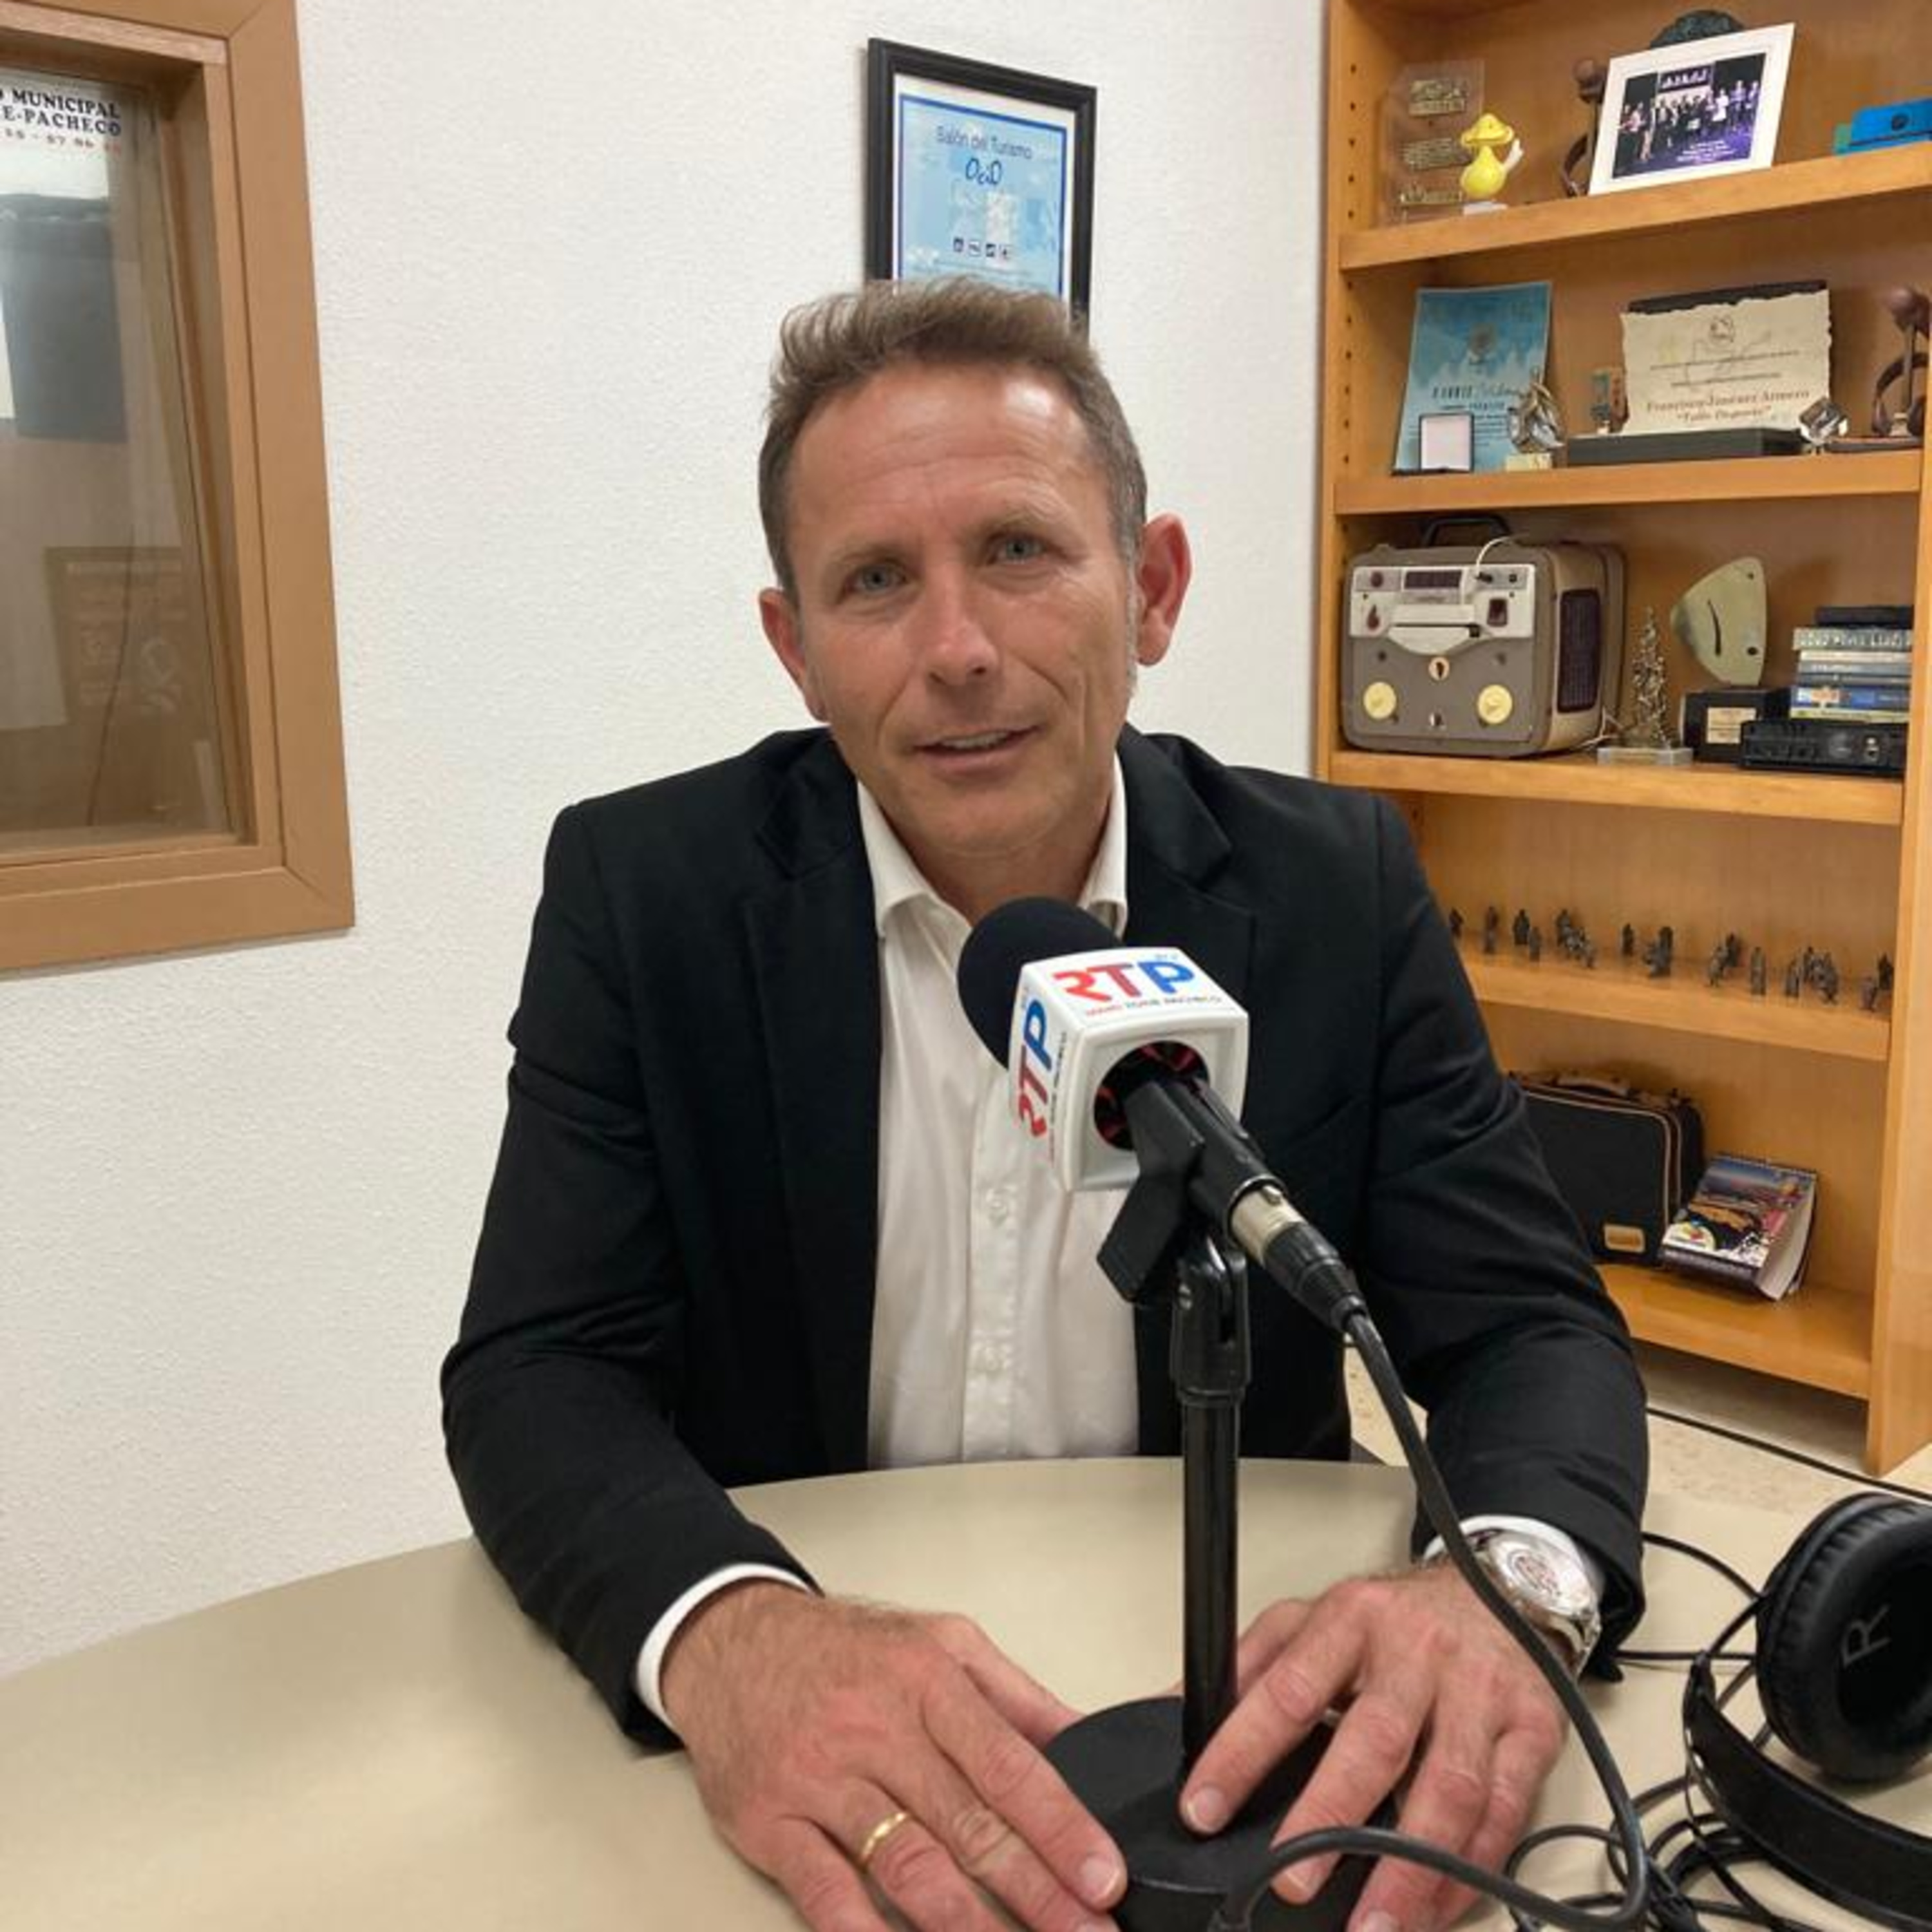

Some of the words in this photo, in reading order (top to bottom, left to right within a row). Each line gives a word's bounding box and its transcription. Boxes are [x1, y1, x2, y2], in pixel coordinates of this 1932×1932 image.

[12, 88, 121, 118] MUNICIPAL
[1052, 961, 1195, 1003] RTP
[1841, 1605, 1891, 1668] R
